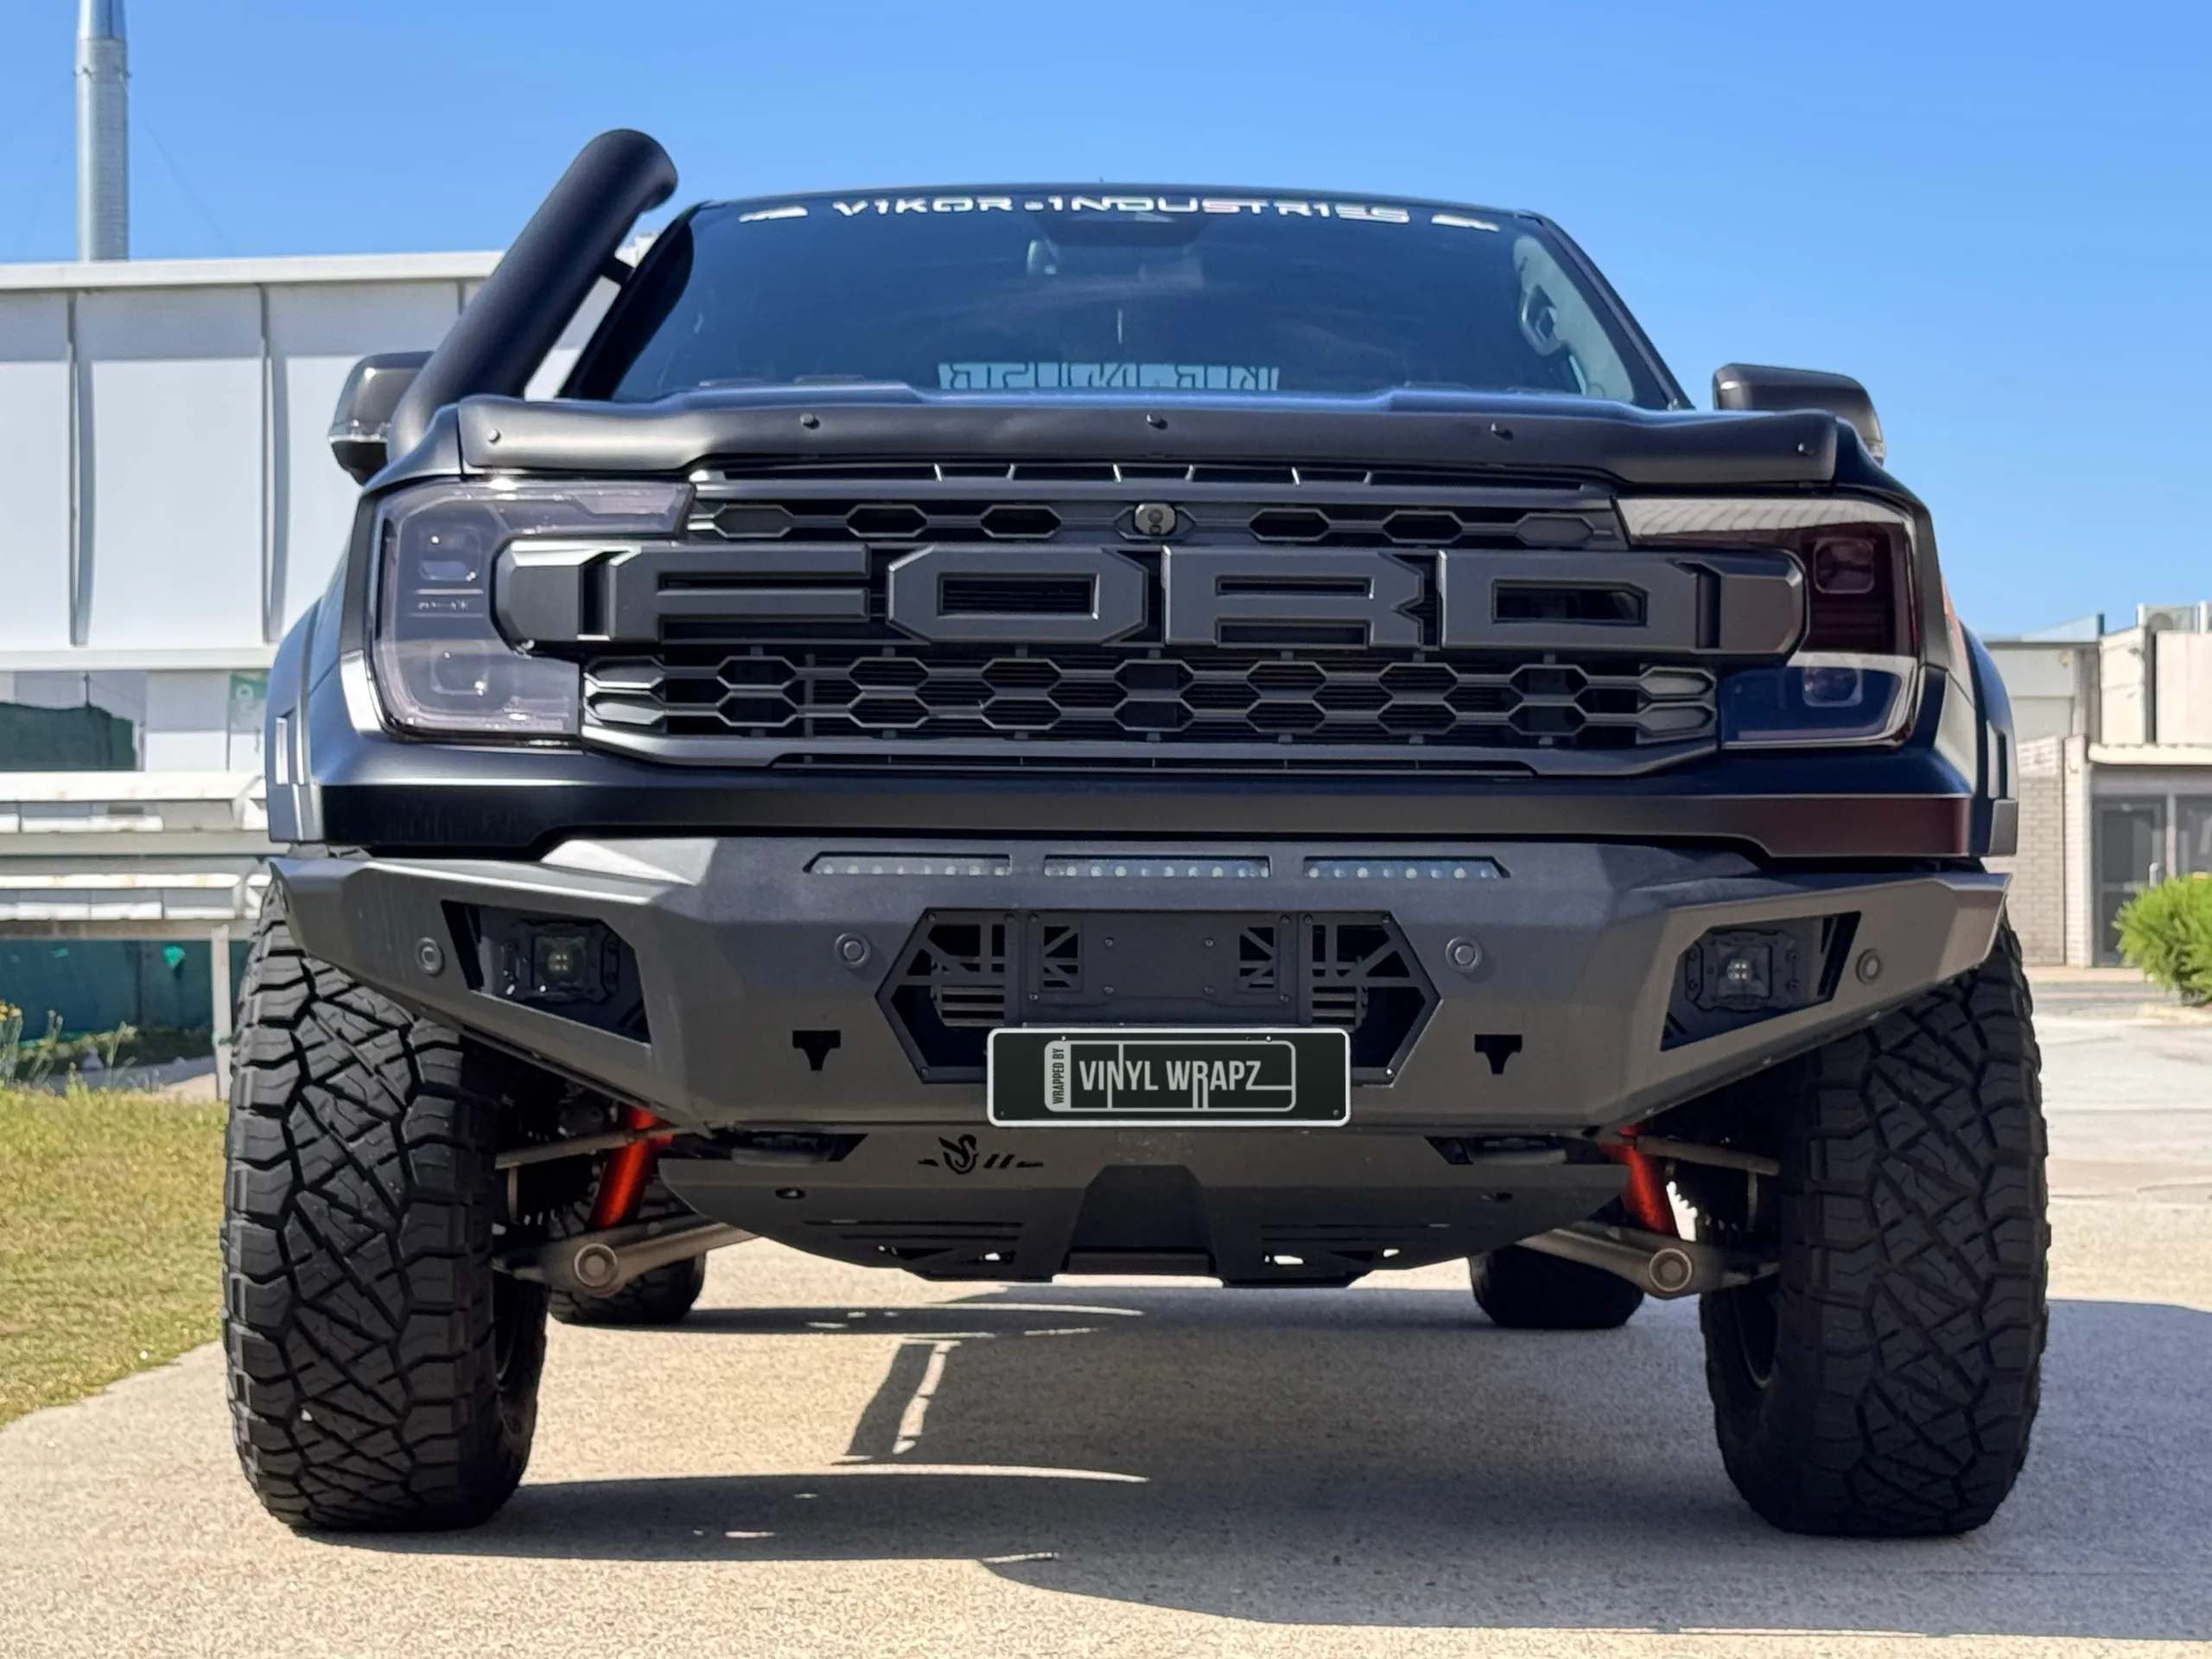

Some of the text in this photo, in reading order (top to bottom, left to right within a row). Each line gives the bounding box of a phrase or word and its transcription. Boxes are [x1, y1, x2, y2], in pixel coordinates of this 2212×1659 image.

[607, 541, 1700, 650] FORD
[1052, 1048, 1065, 1104] WRAPPED BY
[1078, 1059, 1262, 1092] VINYL WRAPZ
